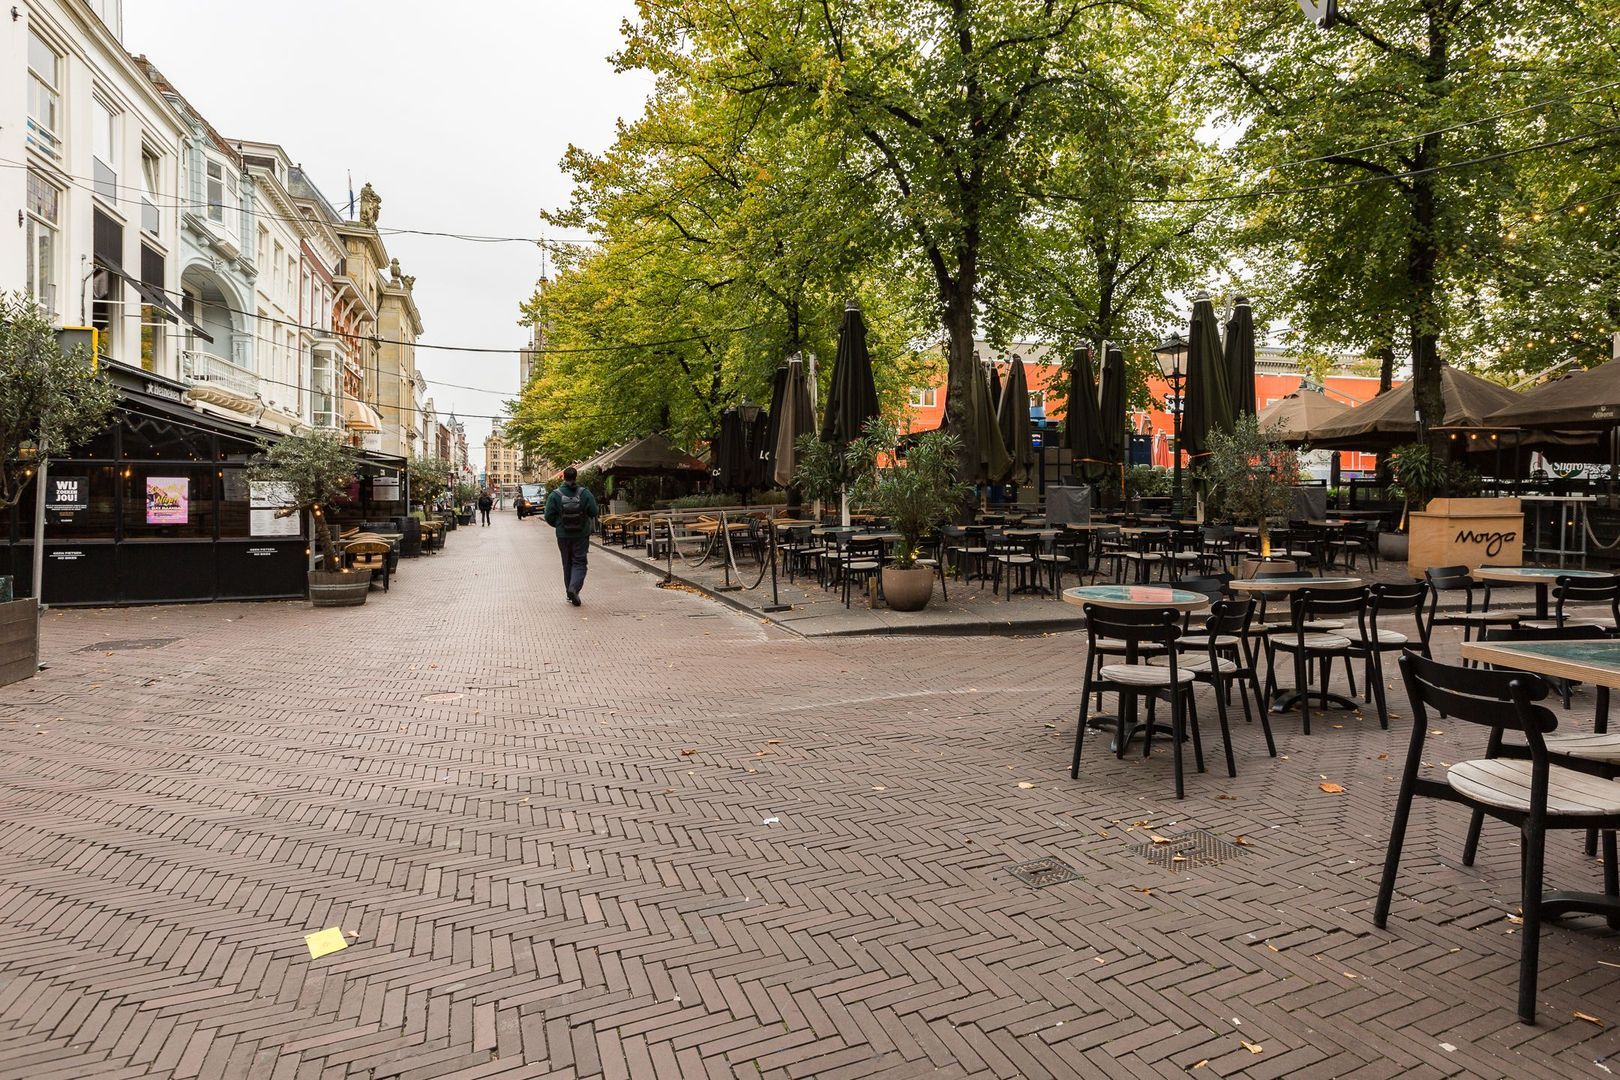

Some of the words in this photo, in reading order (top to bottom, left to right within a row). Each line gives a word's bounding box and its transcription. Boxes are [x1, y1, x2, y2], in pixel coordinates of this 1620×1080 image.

[154, 383, 180, 401] Heineken
[56, 481, 78, 490] WIJ
[56, 494, 78, 502] JOU!
